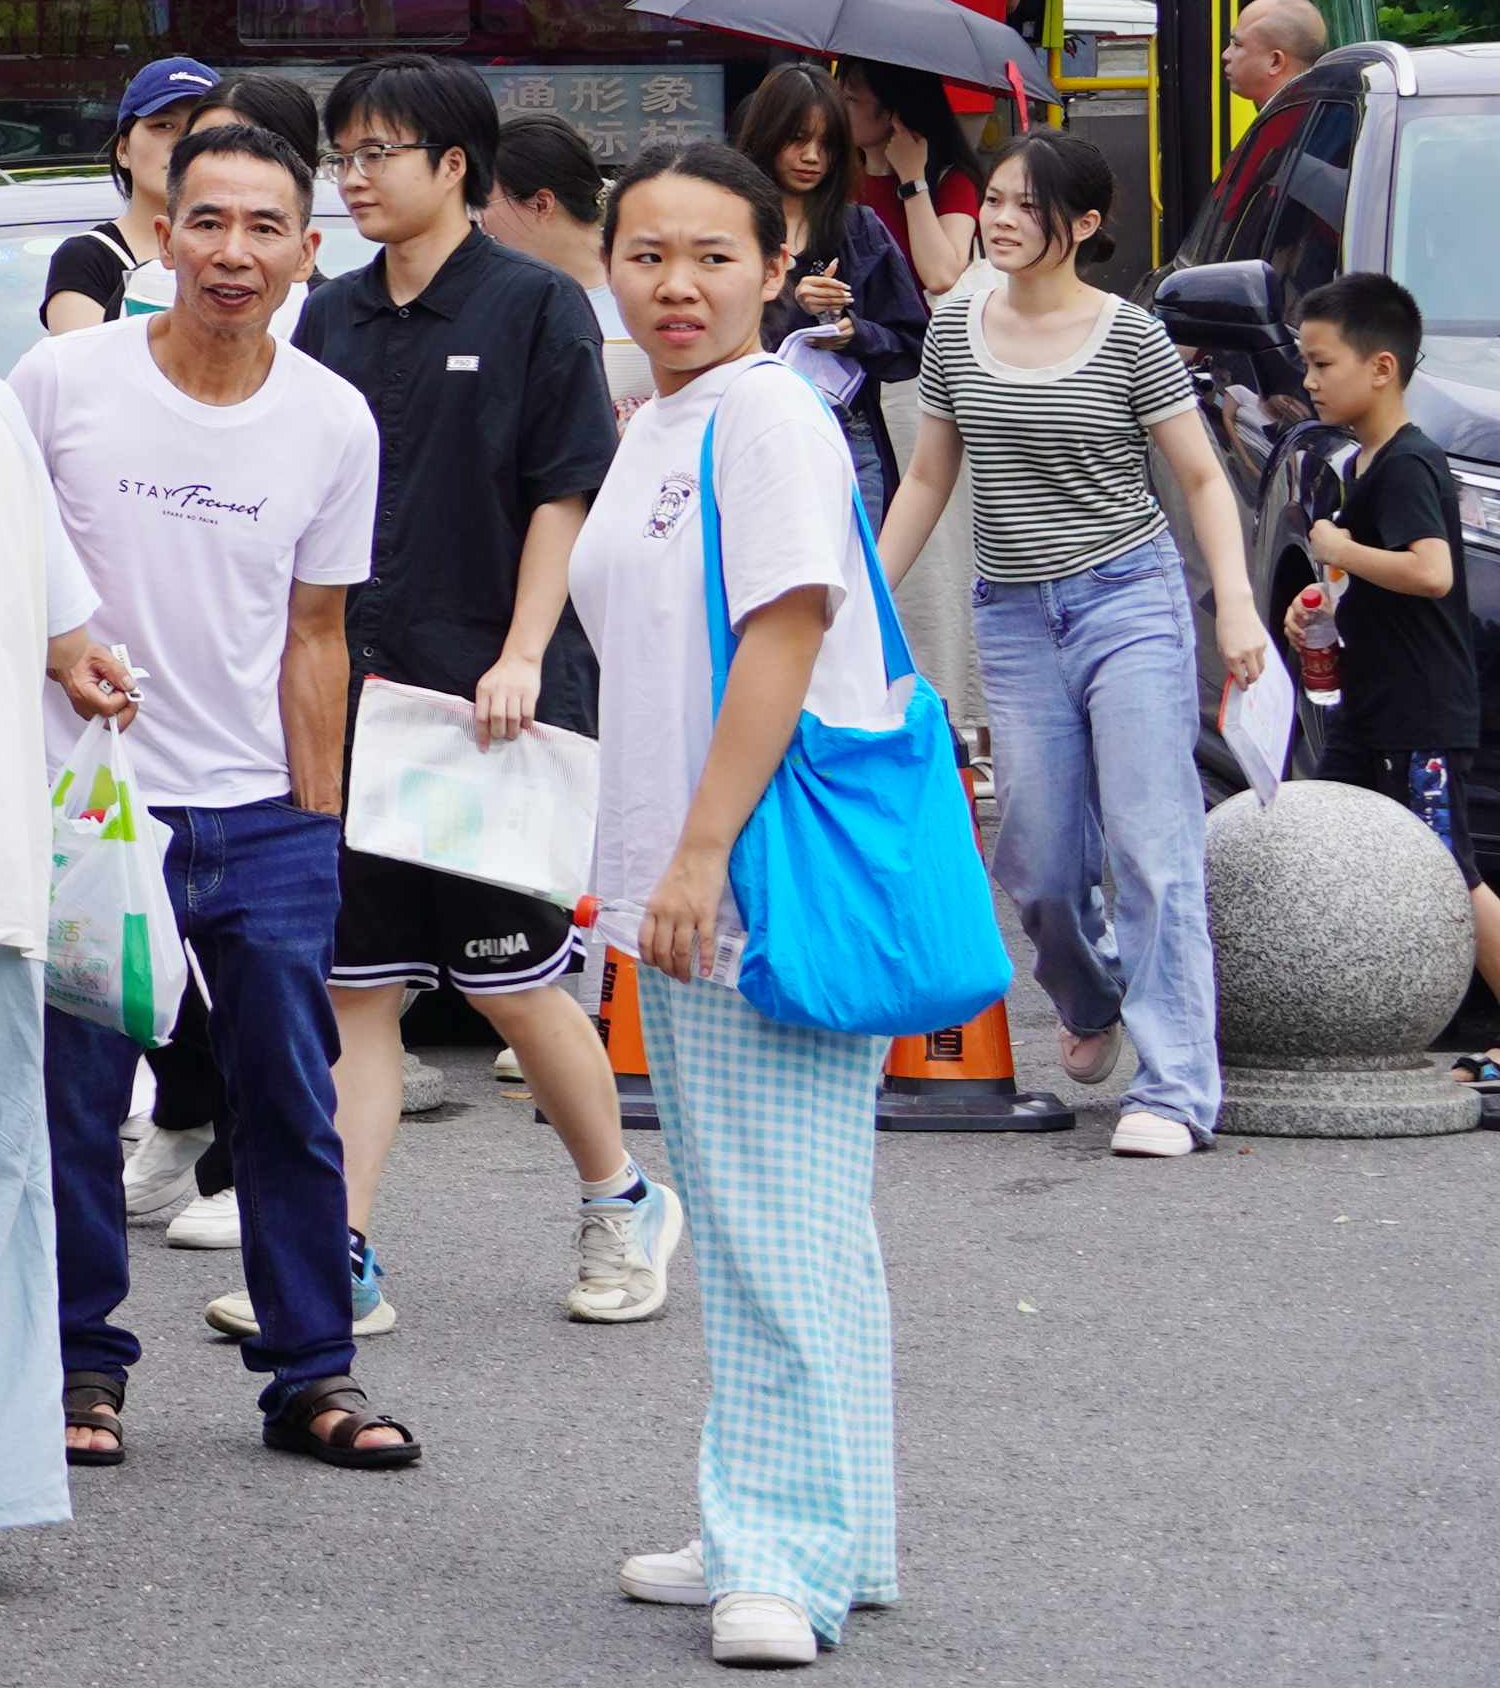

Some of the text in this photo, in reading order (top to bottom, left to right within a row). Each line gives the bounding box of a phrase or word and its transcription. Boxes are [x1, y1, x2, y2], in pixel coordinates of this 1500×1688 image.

[118, 479, 268, 522] STAY Focused
[464, 932, 531, 959] CHINA
